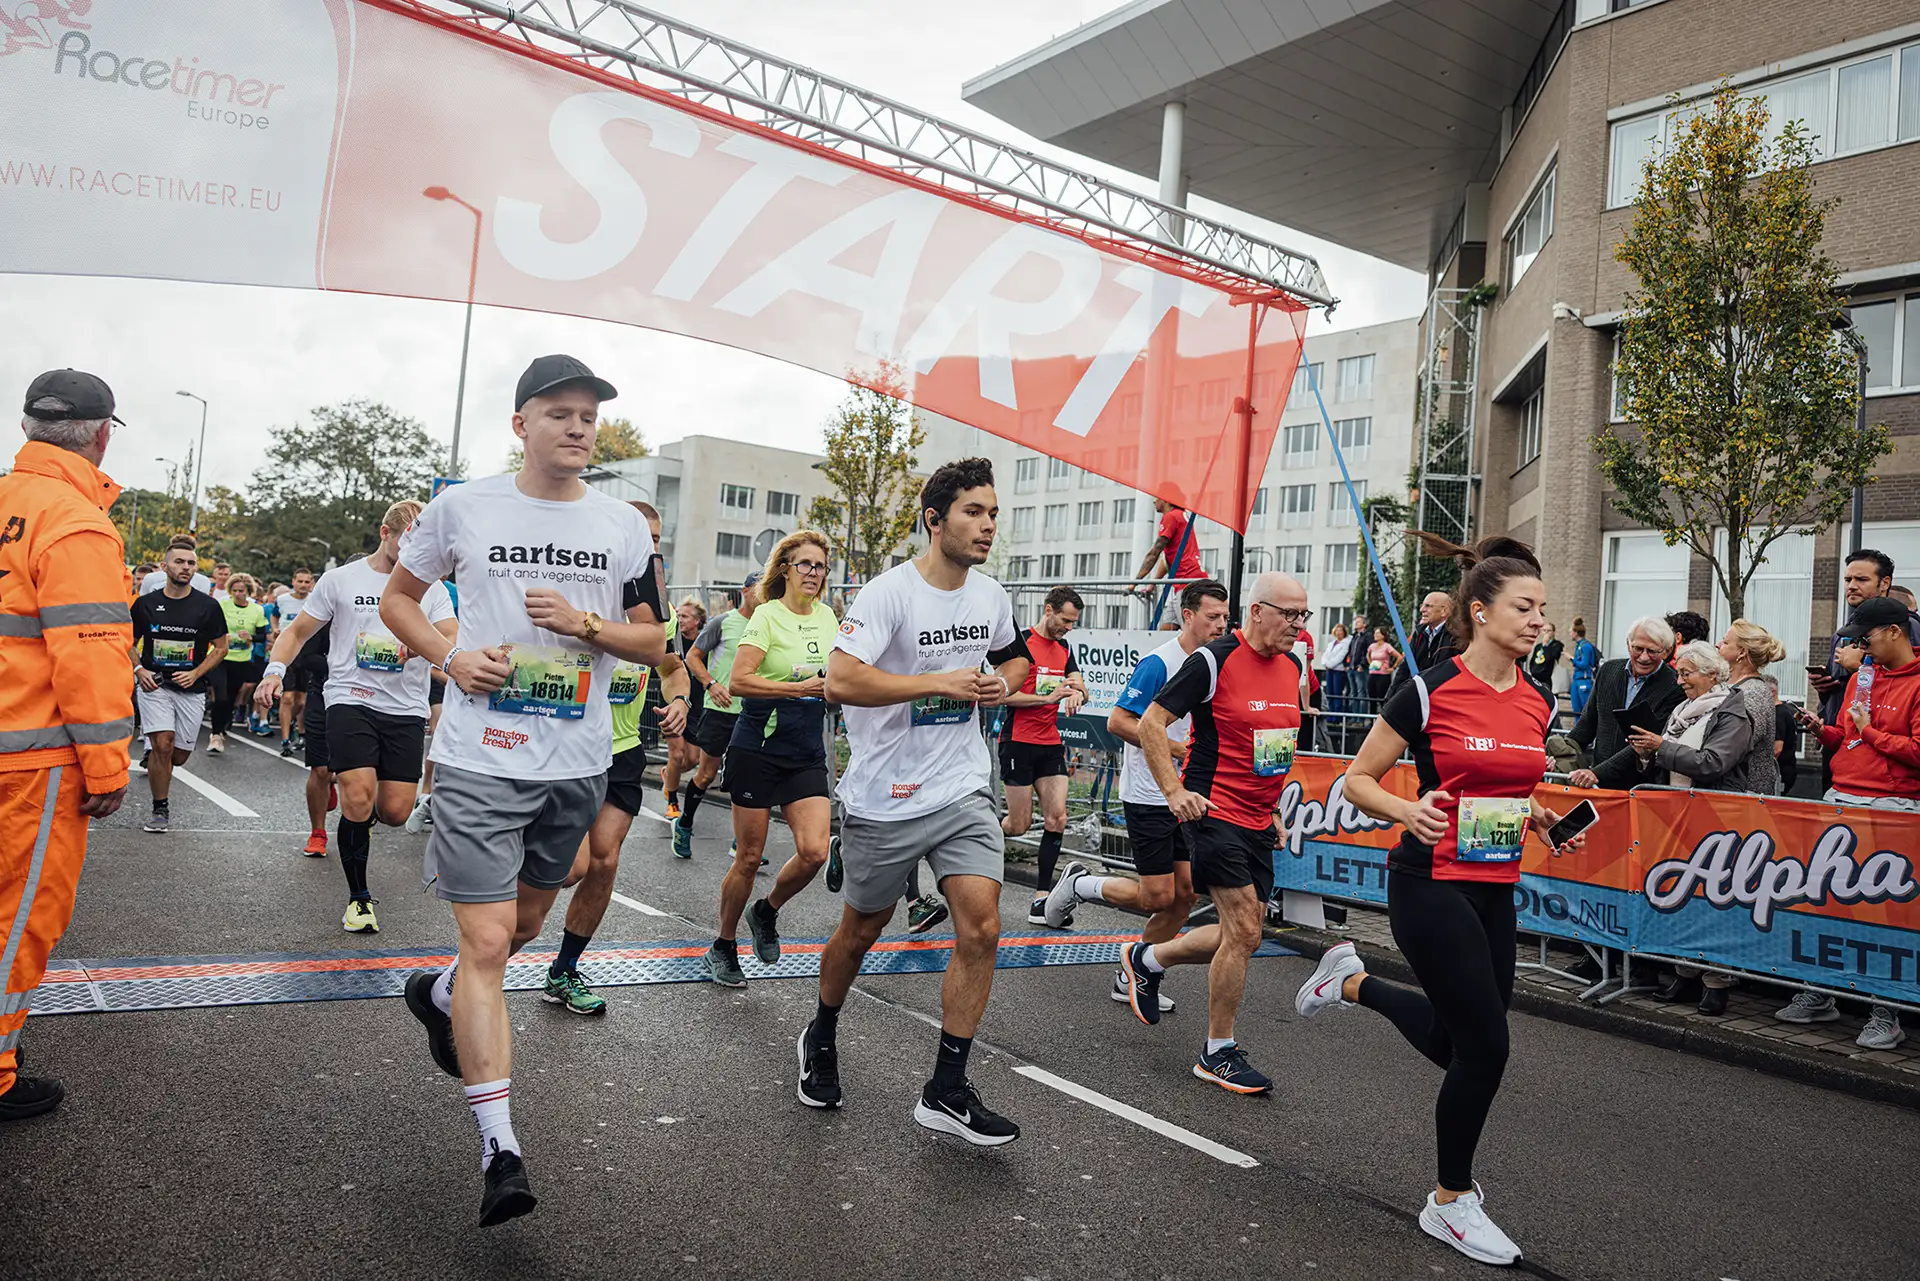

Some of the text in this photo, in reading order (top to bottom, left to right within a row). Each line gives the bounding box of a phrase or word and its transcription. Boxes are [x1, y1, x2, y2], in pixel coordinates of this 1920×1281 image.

[54, 31, 285, 108] Racetimer
[187, 101, 269, 130] Europe
[493, 91, 1220, 437] START
[488, 567, 606, 584] fruit and vegetables
[373, 652, 399, 664] 18726
[919, 649, 935, 658] fruit
[1078, 643, 1140, 668] Ravels
[544, 673, 564, 681] Pieter
[530, 682, 574, 701] 18814
[610, 682, 637, 694] 18283
[1249, 701, 1268, 711] NBU
[484, 727, 529, 744] nonstop
[1465, 737, 1496, 751] NBU
[891, 783, 920, 791] nonsto
[1645, 824, 1916, 929] Alpha
